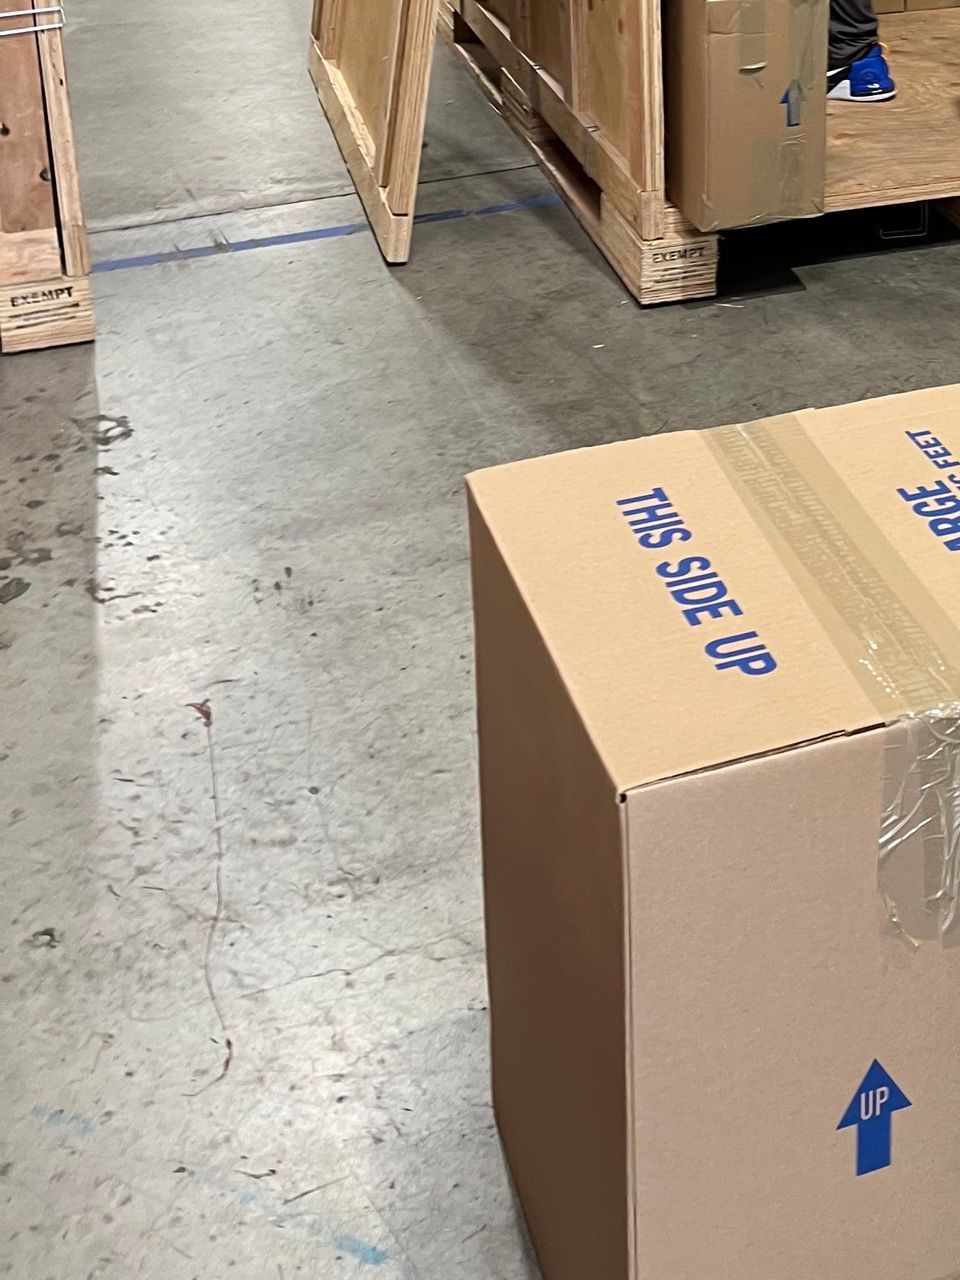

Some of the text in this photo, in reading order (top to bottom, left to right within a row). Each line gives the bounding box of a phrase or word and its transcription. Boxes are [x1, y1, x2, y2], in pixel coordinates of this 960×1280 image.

[10, 286, 74, 307] EXEMPT
[615, 487, 778, 675] THIS SIDE UP
[860, 1086, 889, 1121] UP
